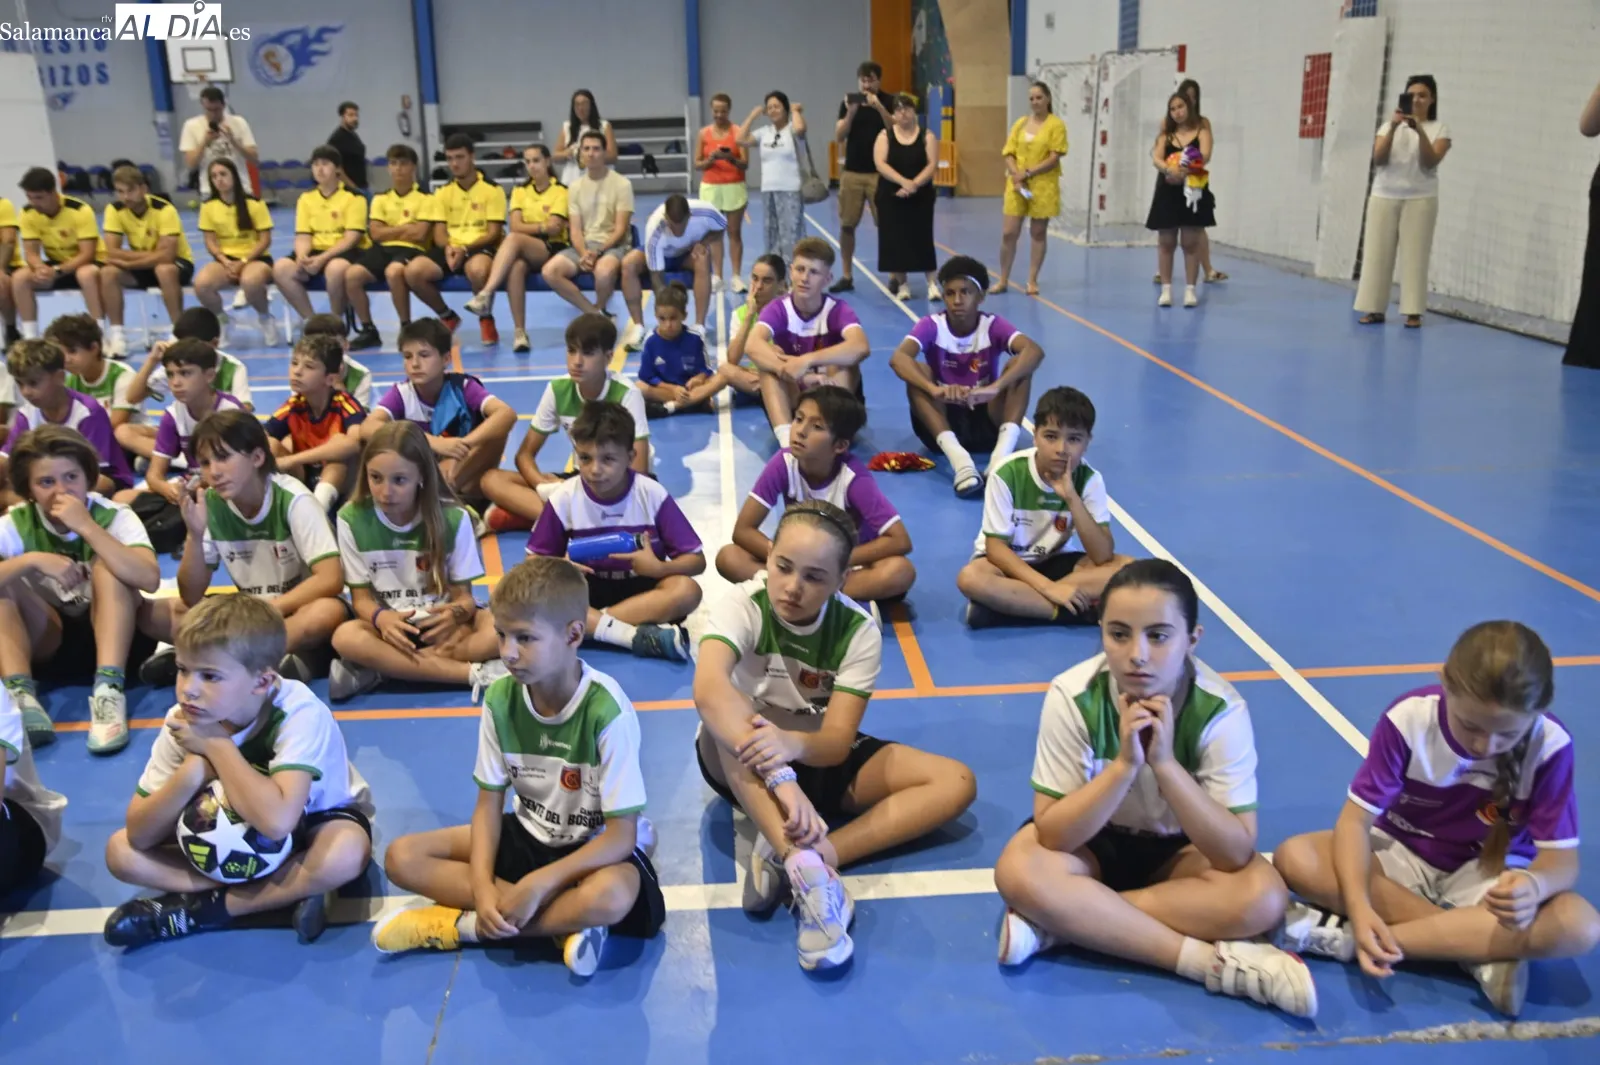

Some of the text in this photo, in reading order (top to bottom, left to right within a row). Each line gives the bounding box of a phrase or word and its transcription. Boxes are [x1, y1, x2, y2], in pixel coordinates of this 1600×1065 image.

[39, 62, 110, 88] IZOS
[405, 588, 419, 598] DEL
[519, 796, 605, 830] CENTE DEL BOSQU
